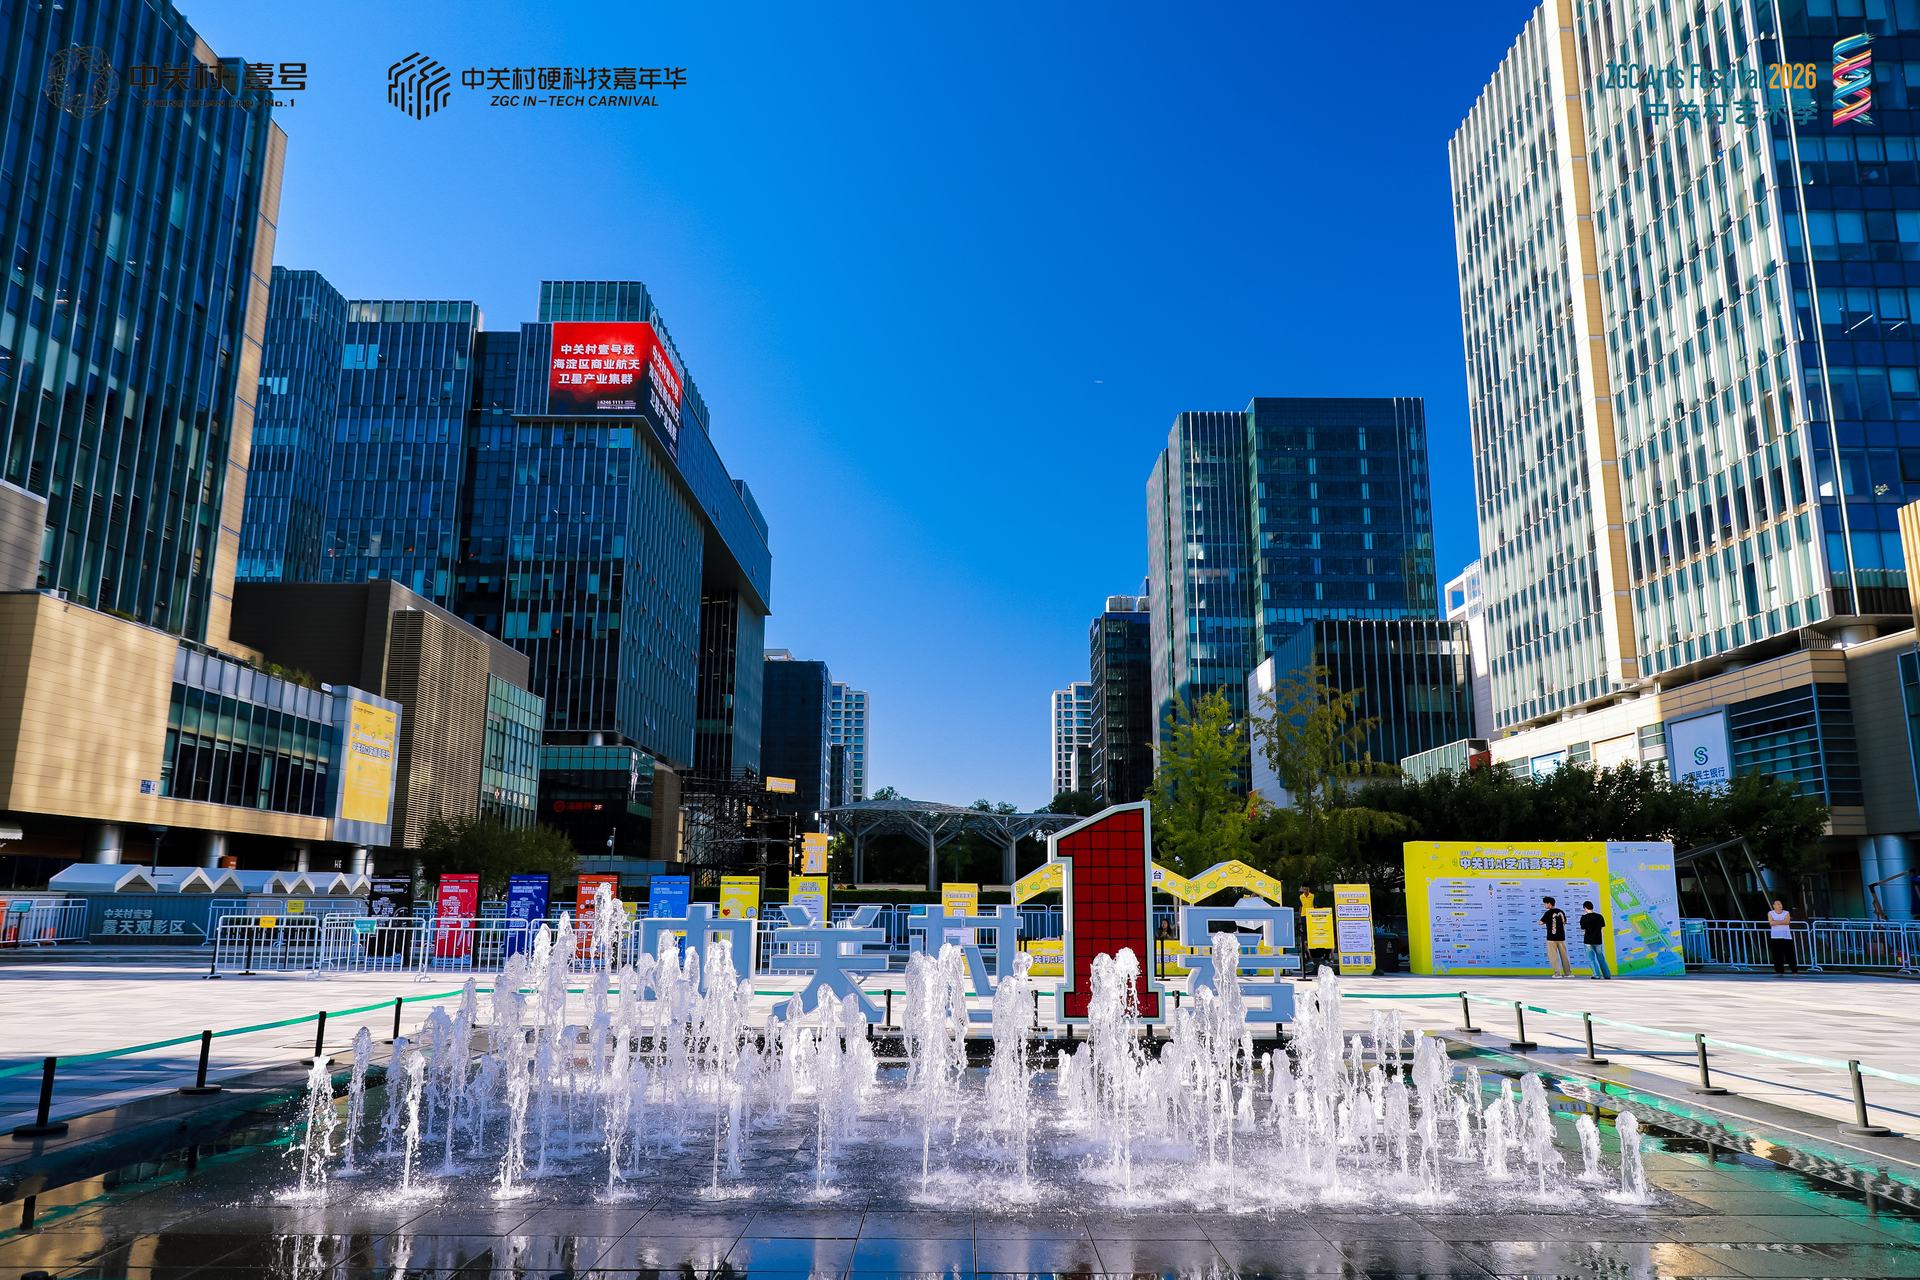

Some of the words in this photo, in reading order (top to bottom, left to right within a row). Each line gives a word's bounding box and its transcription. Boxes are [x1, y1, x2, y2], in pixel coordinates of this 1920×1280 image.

[560, 344, 635, 355] 中关村壹号获
[553, 358, 641, 370] 海淀区商业航天
[558, 373, 633, 385] 卫星产业集群
[1459, 857, 1566, 871] 中关村AI艺术嘉年华
[103, 908, 152, 919] 中关村壹号
[101, 919, 186, 934] 露天观影区
